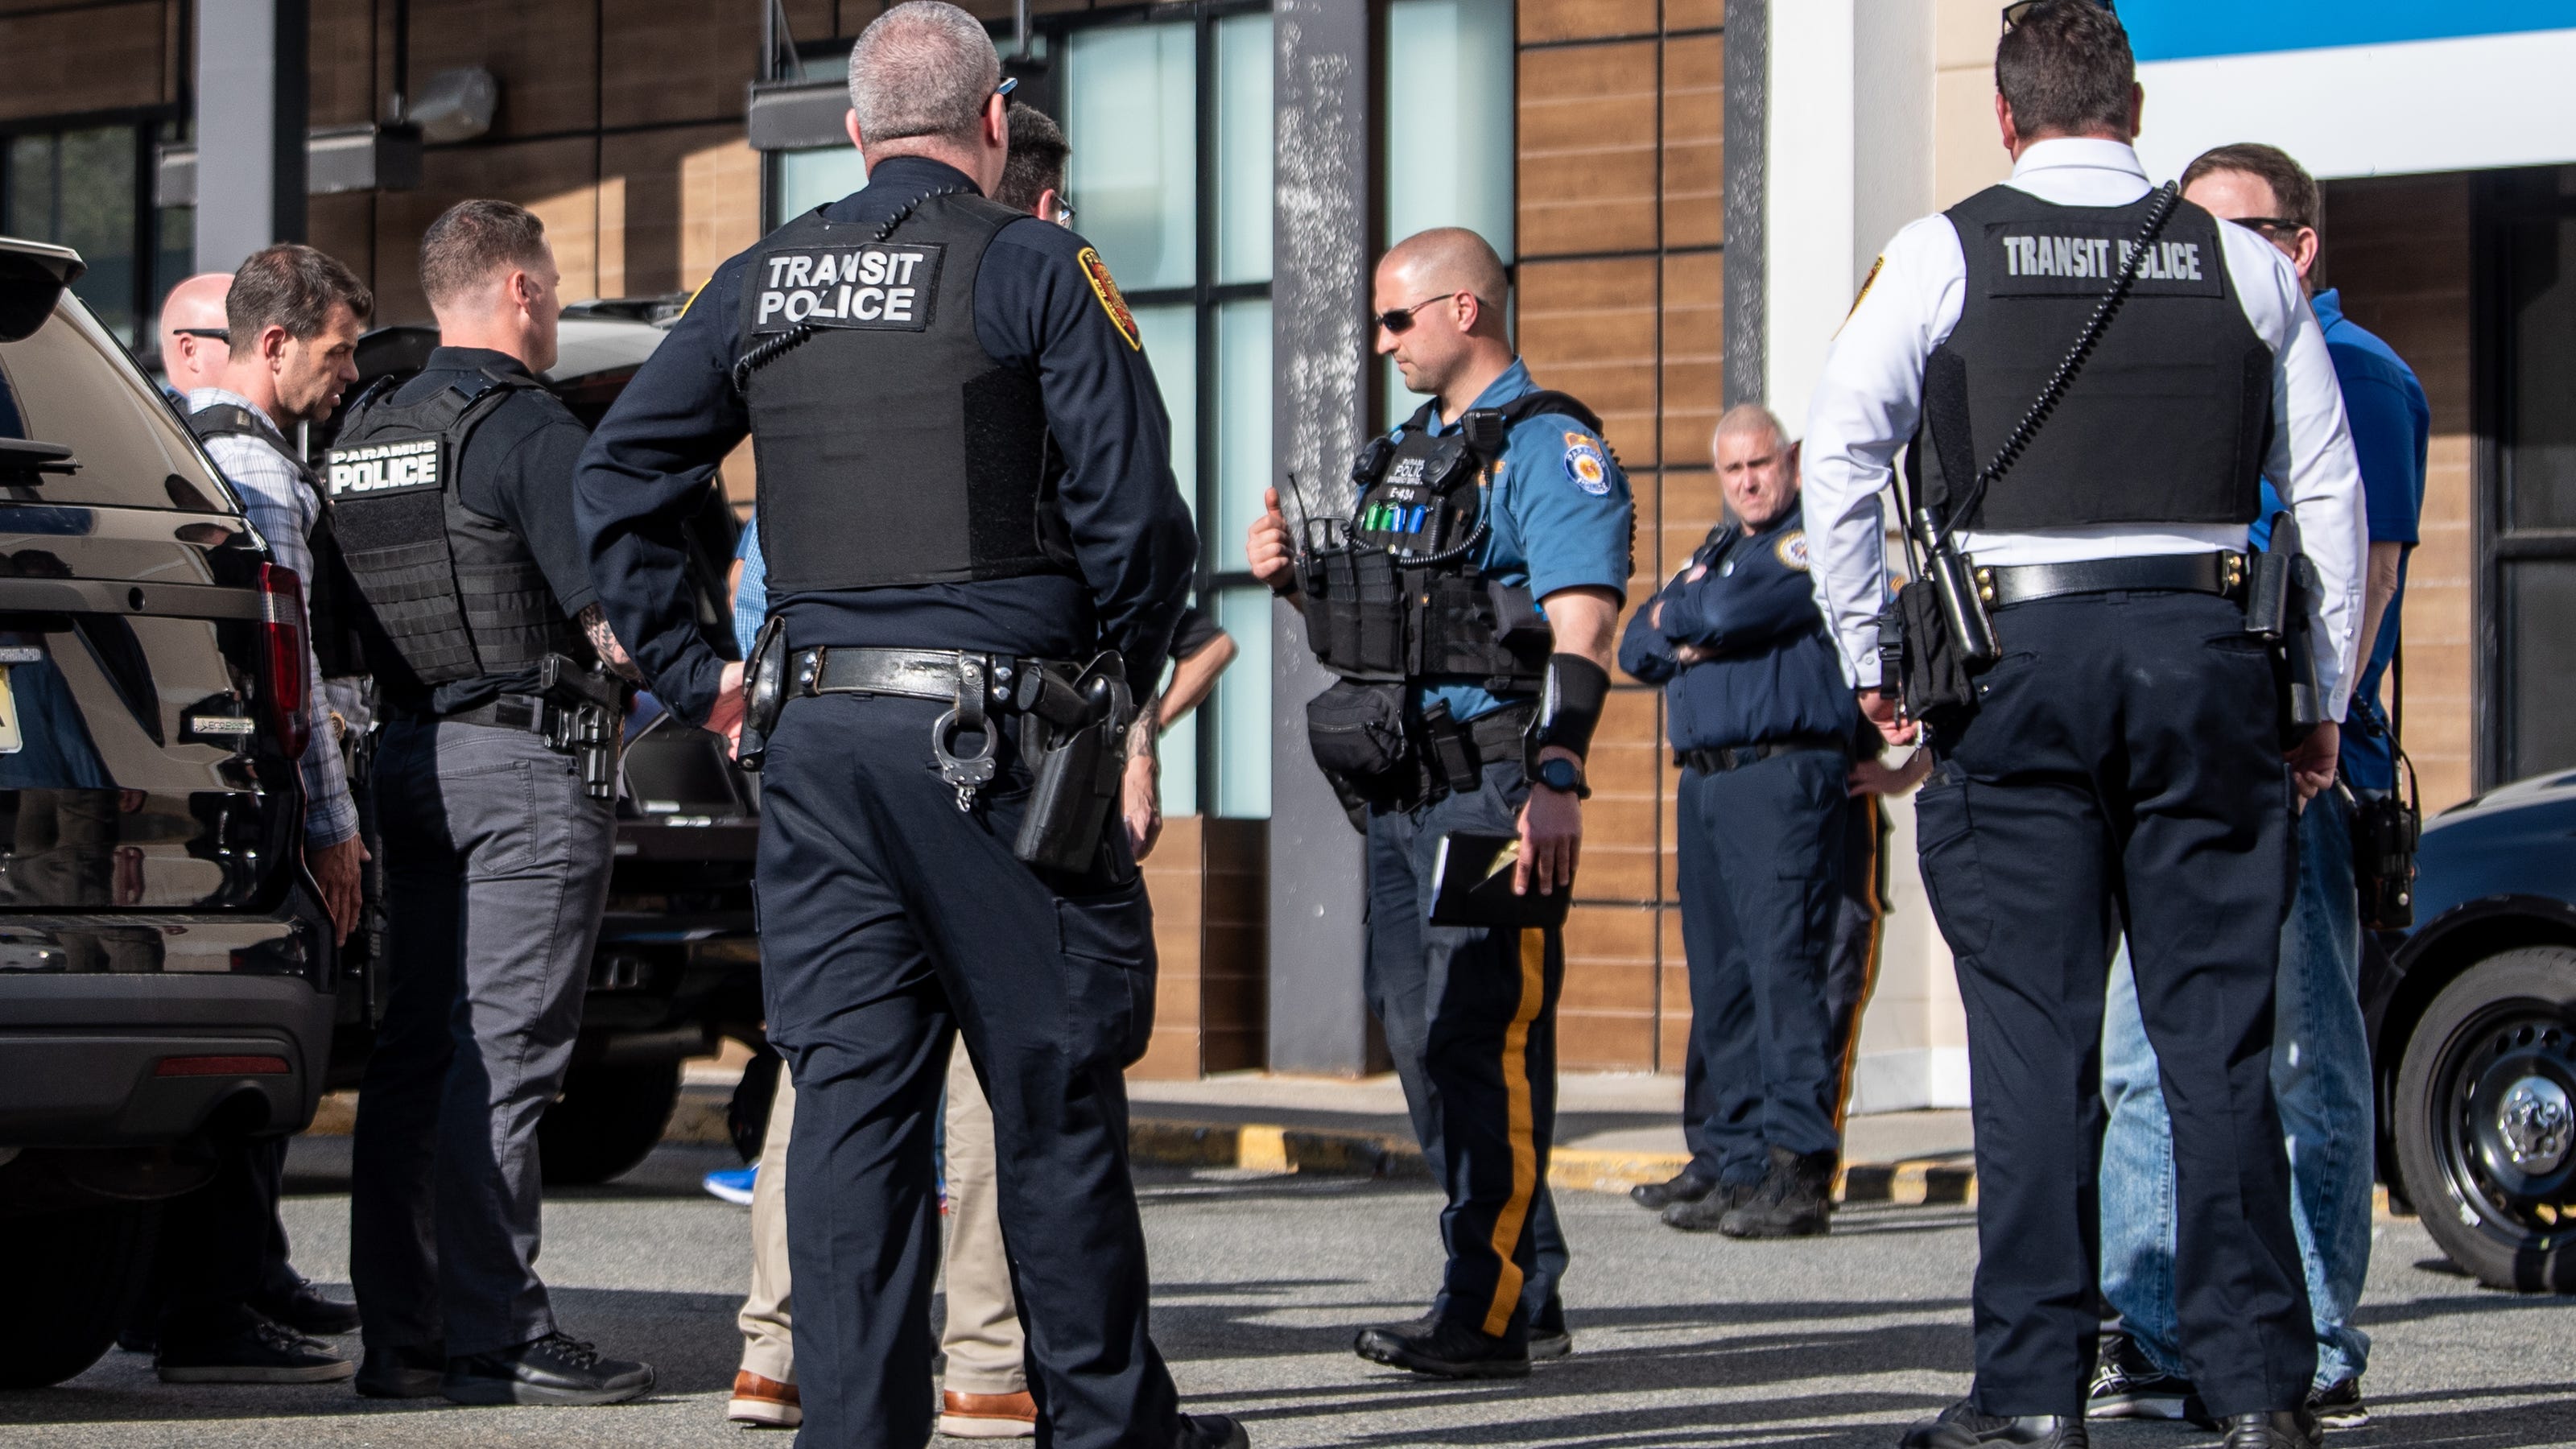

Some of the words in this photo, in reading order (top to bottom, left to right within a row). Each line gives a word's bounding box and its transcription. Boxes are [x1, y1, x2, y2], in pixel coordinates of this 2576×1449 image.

[769, 250, 924, 288] TRANSIT
[2003, 236, 2109, 278] TRANSIT
[758, 284, 916, 324] POLICE
[329, 440, 436, 464] PARAMUS
[1394, 464, 1424, 477] POLIC
[329, 454, 436, 495] POLICE
